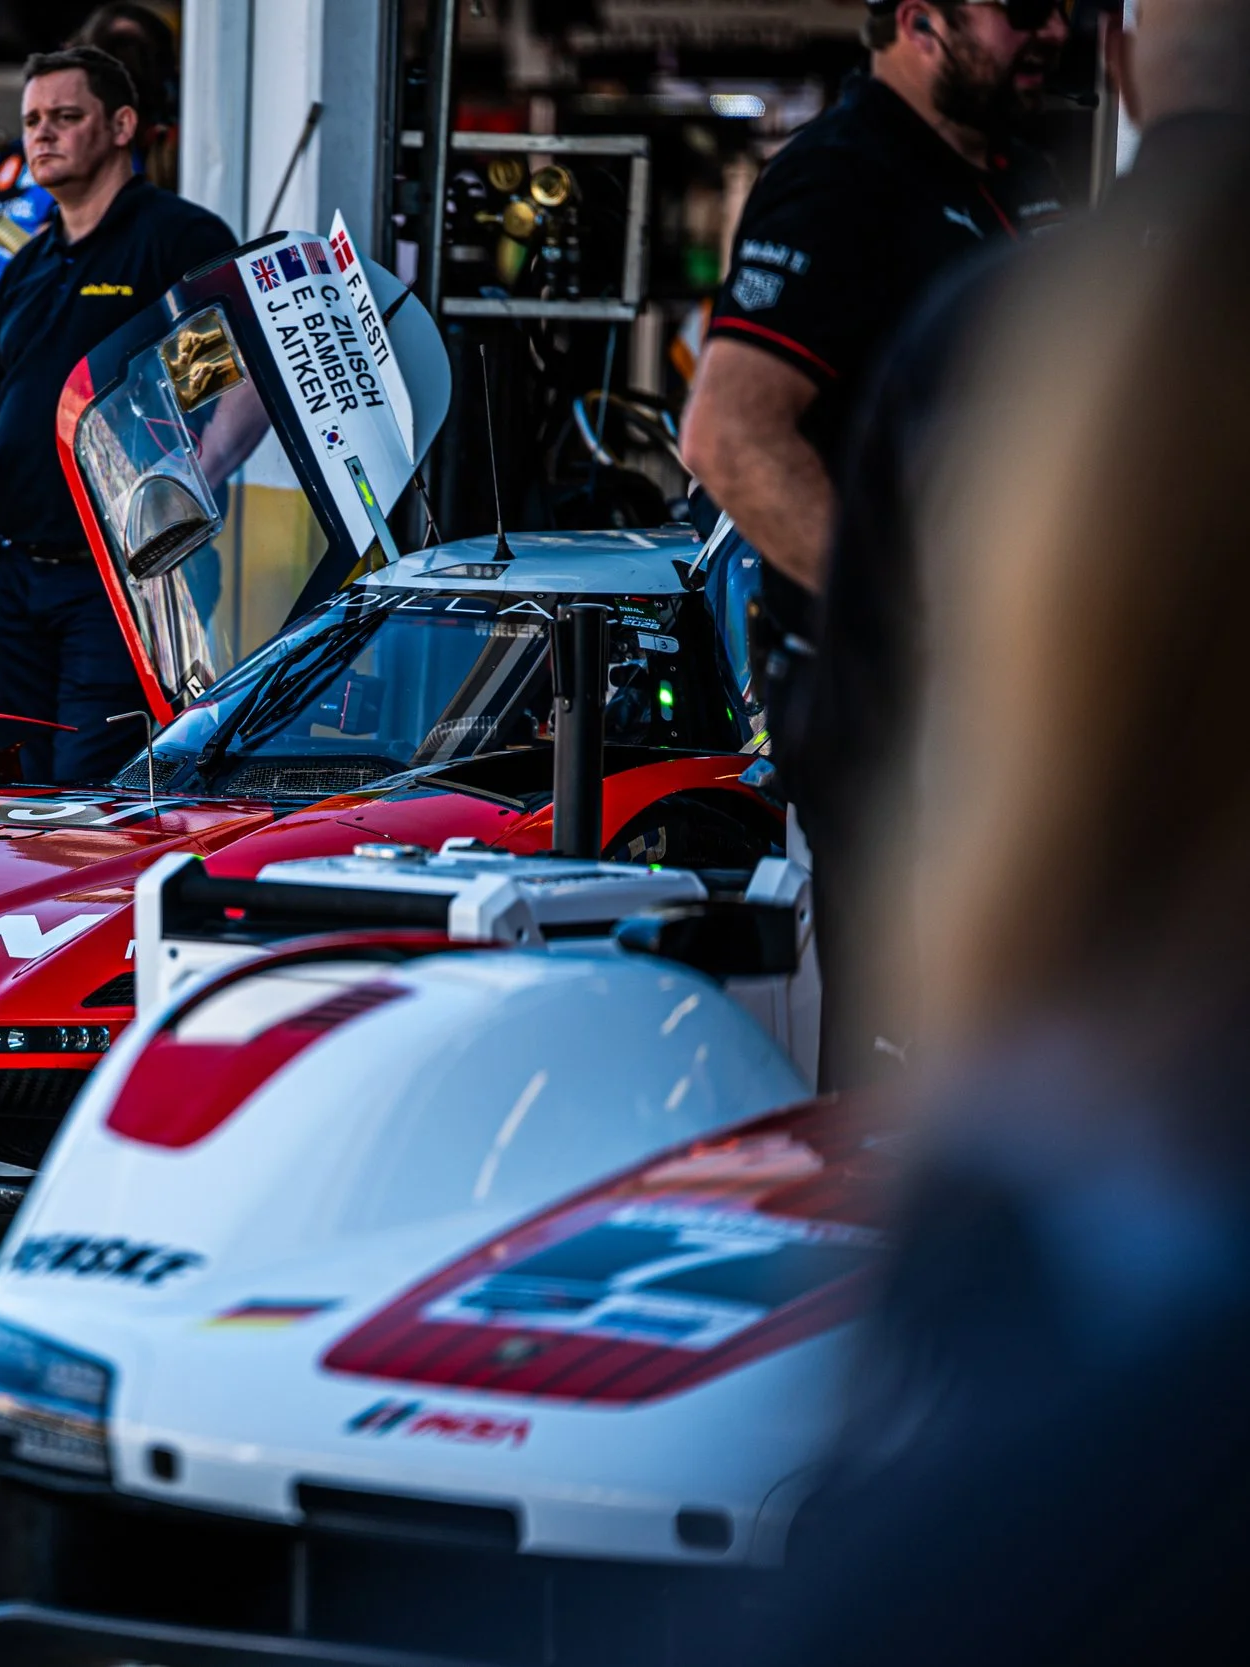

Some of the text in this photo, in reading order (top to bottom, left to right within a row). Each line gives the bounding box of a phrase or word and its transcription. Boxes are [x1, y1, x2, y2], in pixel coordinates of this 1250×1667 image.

[267, 301, 331, 415] J. AITKEN
[292, 285, 358, 414] E. BAMBER
[320, 285, 384, 407] C. ZILISCH
[347, 272, 390, 366] F. VESTI
